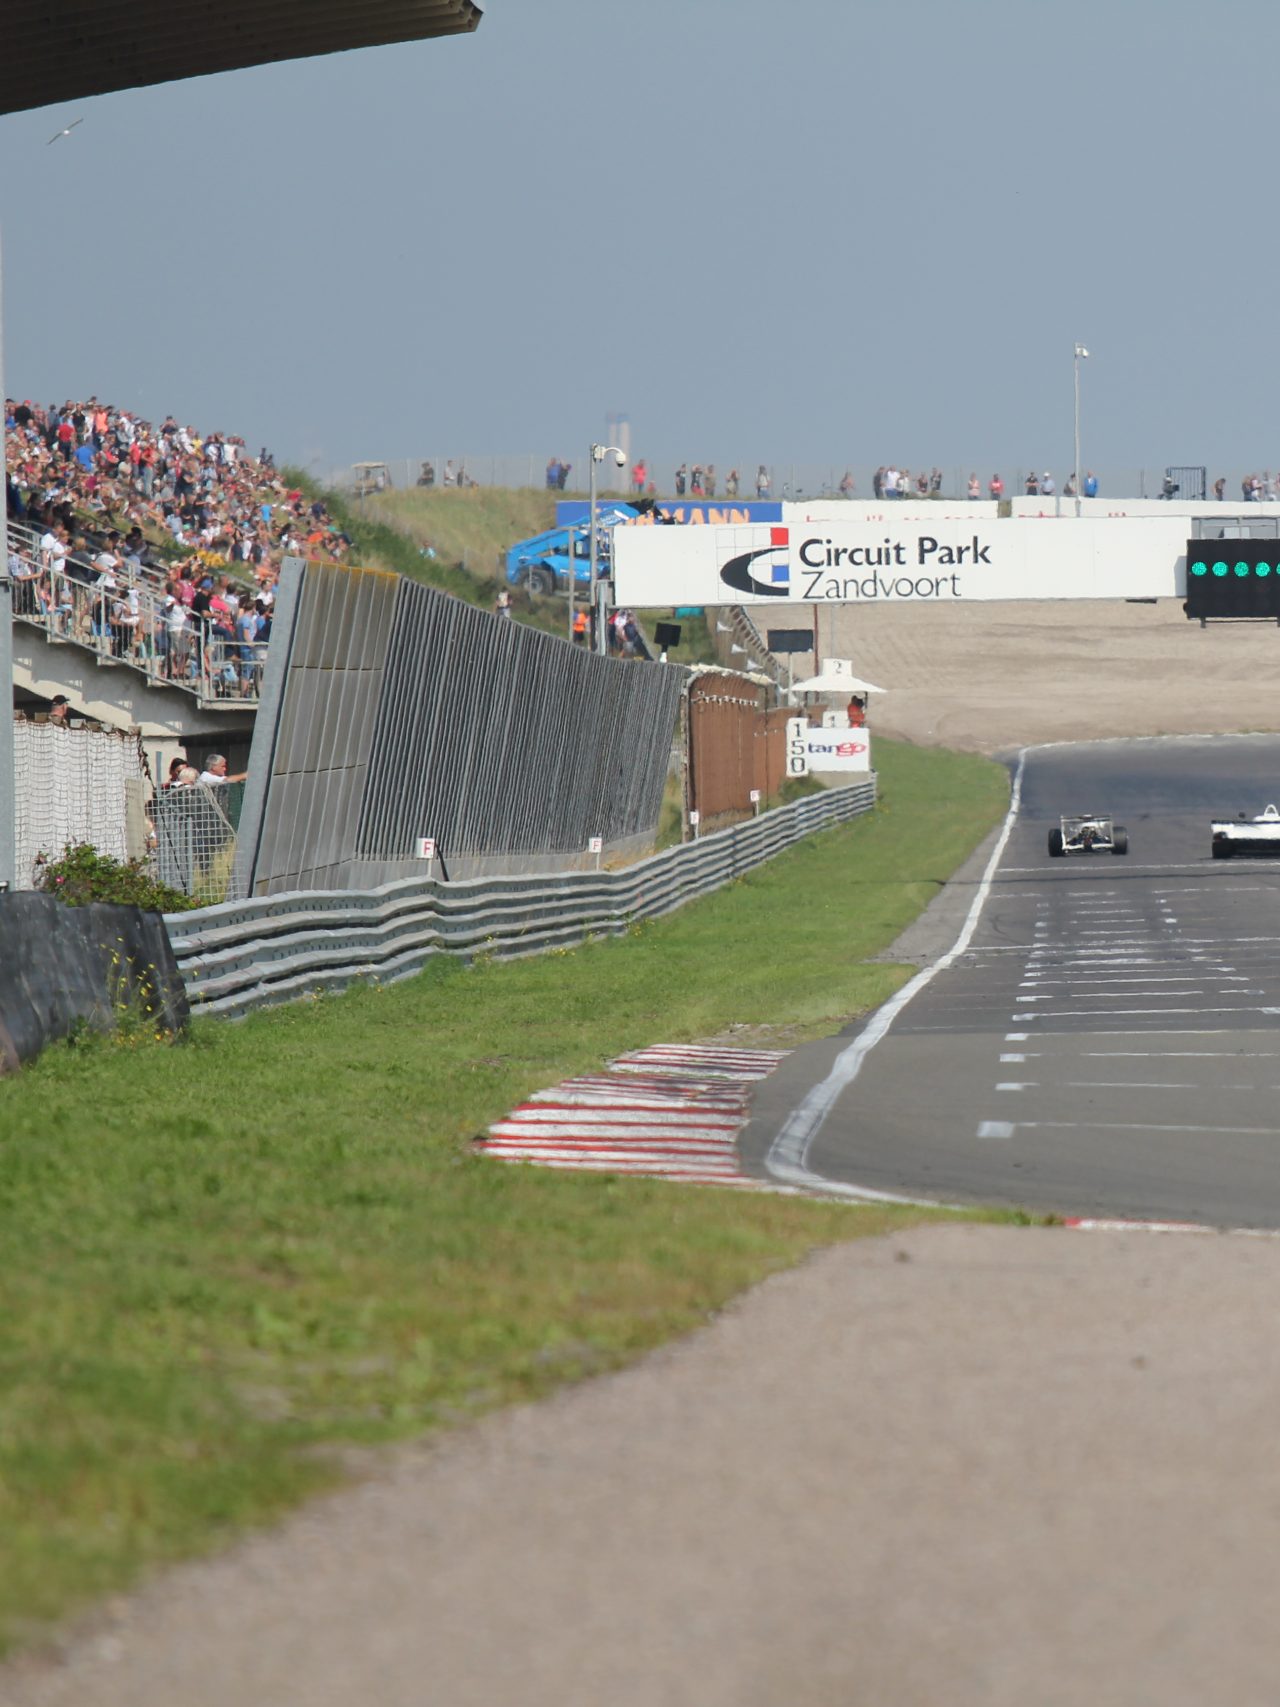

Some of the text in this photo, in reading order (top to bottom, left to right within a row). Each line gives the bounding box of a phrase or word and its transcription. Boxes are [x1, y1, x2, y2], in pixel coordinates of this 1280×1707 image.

[799, 535, 992, 568] Circuit Park
[801, 570, 962, 599] Zandvoort
